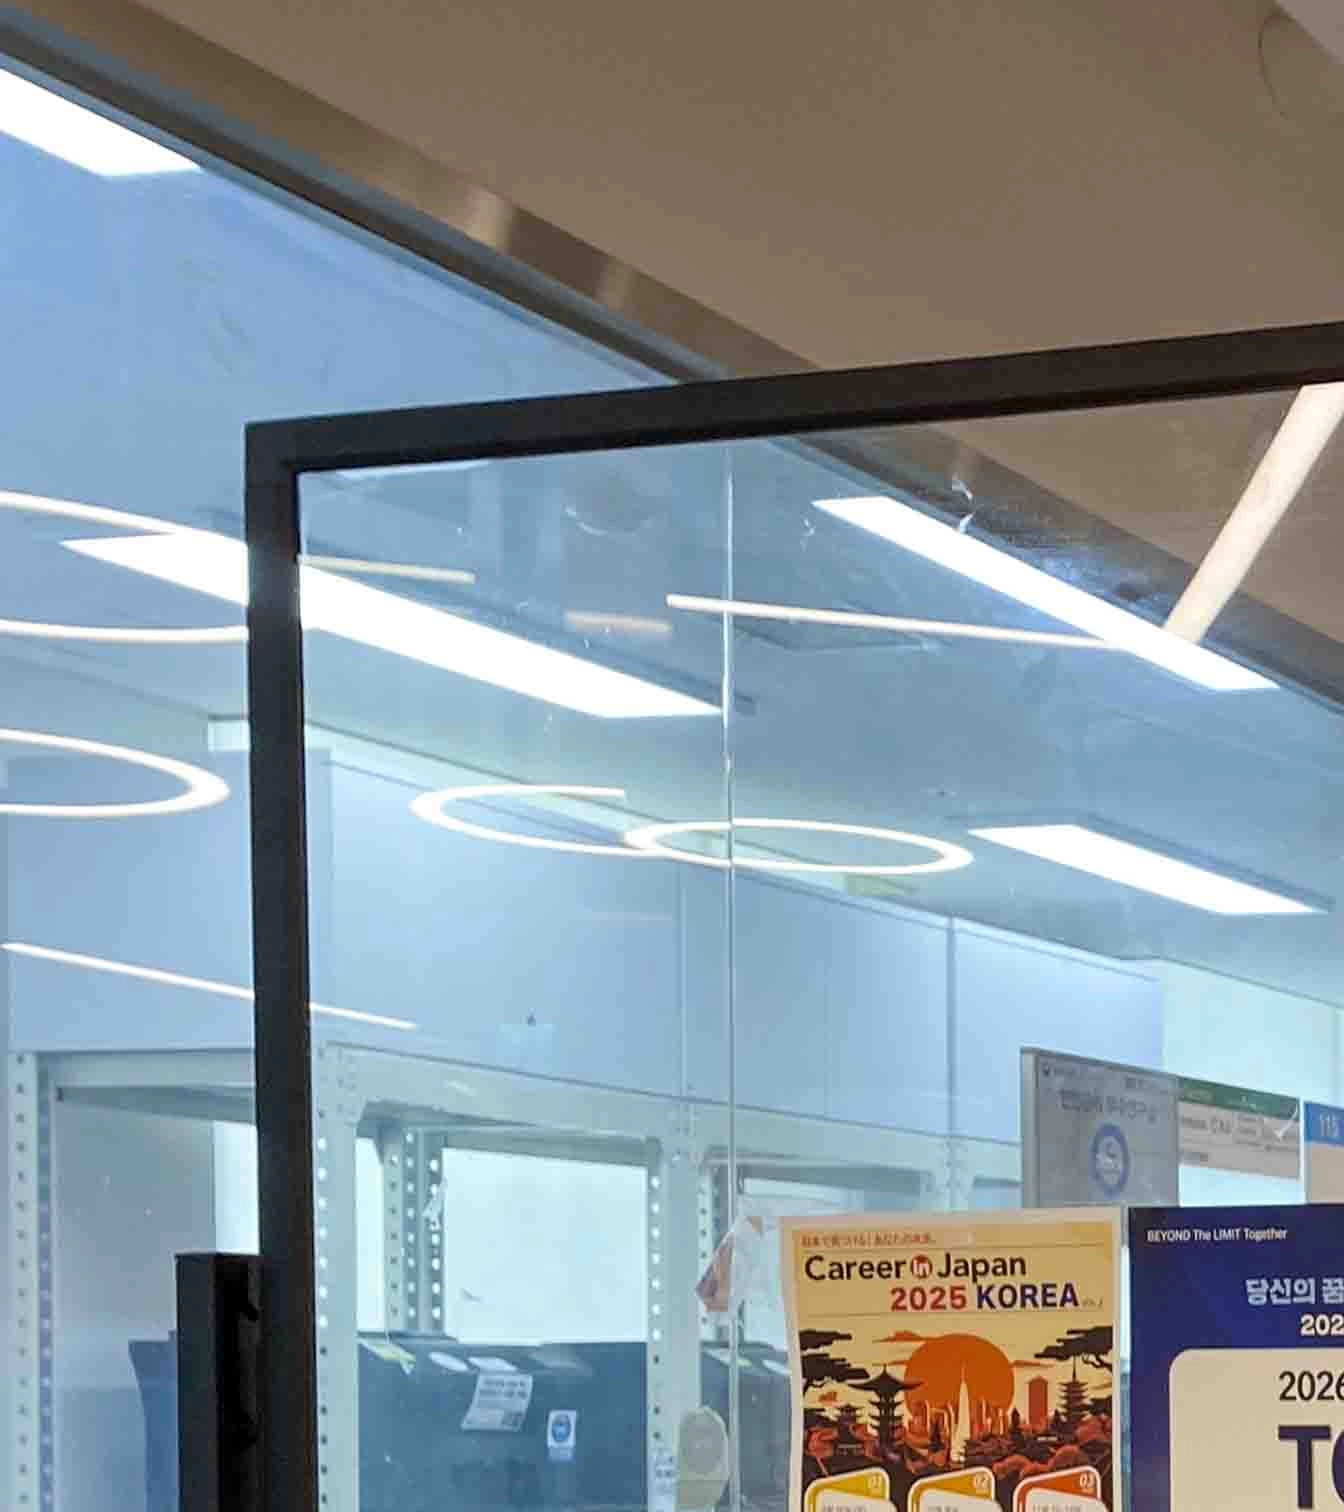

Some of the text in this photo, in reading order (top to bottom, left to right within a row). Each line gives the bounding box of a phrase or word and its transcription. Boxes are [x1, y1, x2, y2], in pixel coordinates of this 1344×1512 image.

[1148, 1228, 1287, 1242] BEYOND The LIMIT Together
[805, 1255, 906, 1280] Career
[938, 1253, 1026, 1284] Japan
[891, 1283, 1079, 1311] 2025 KOREA
[1246, 1278, 1315, 1305] 당신의
